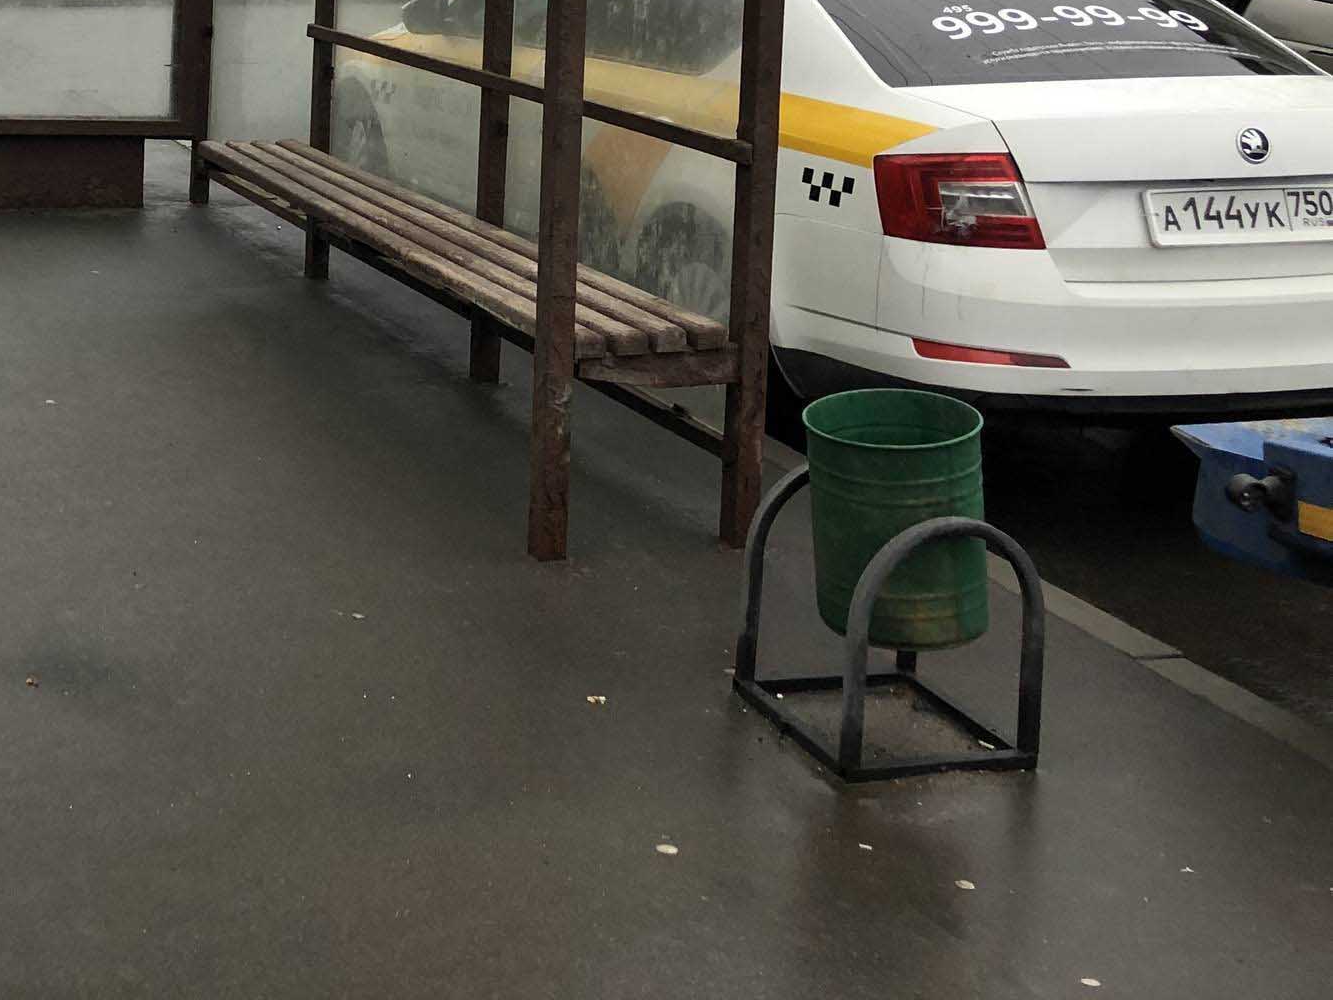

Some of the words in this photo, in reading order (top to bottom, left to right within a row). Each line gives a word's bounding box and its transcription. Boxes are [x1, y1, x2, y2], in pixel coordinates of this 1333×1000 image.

[932, 5, 1209, 40] 999-99-99
[943, 4, 973, 14] 495
[1164, 195, 1285, 231] А144УК
[1287, 190, 1333, 217] 750
